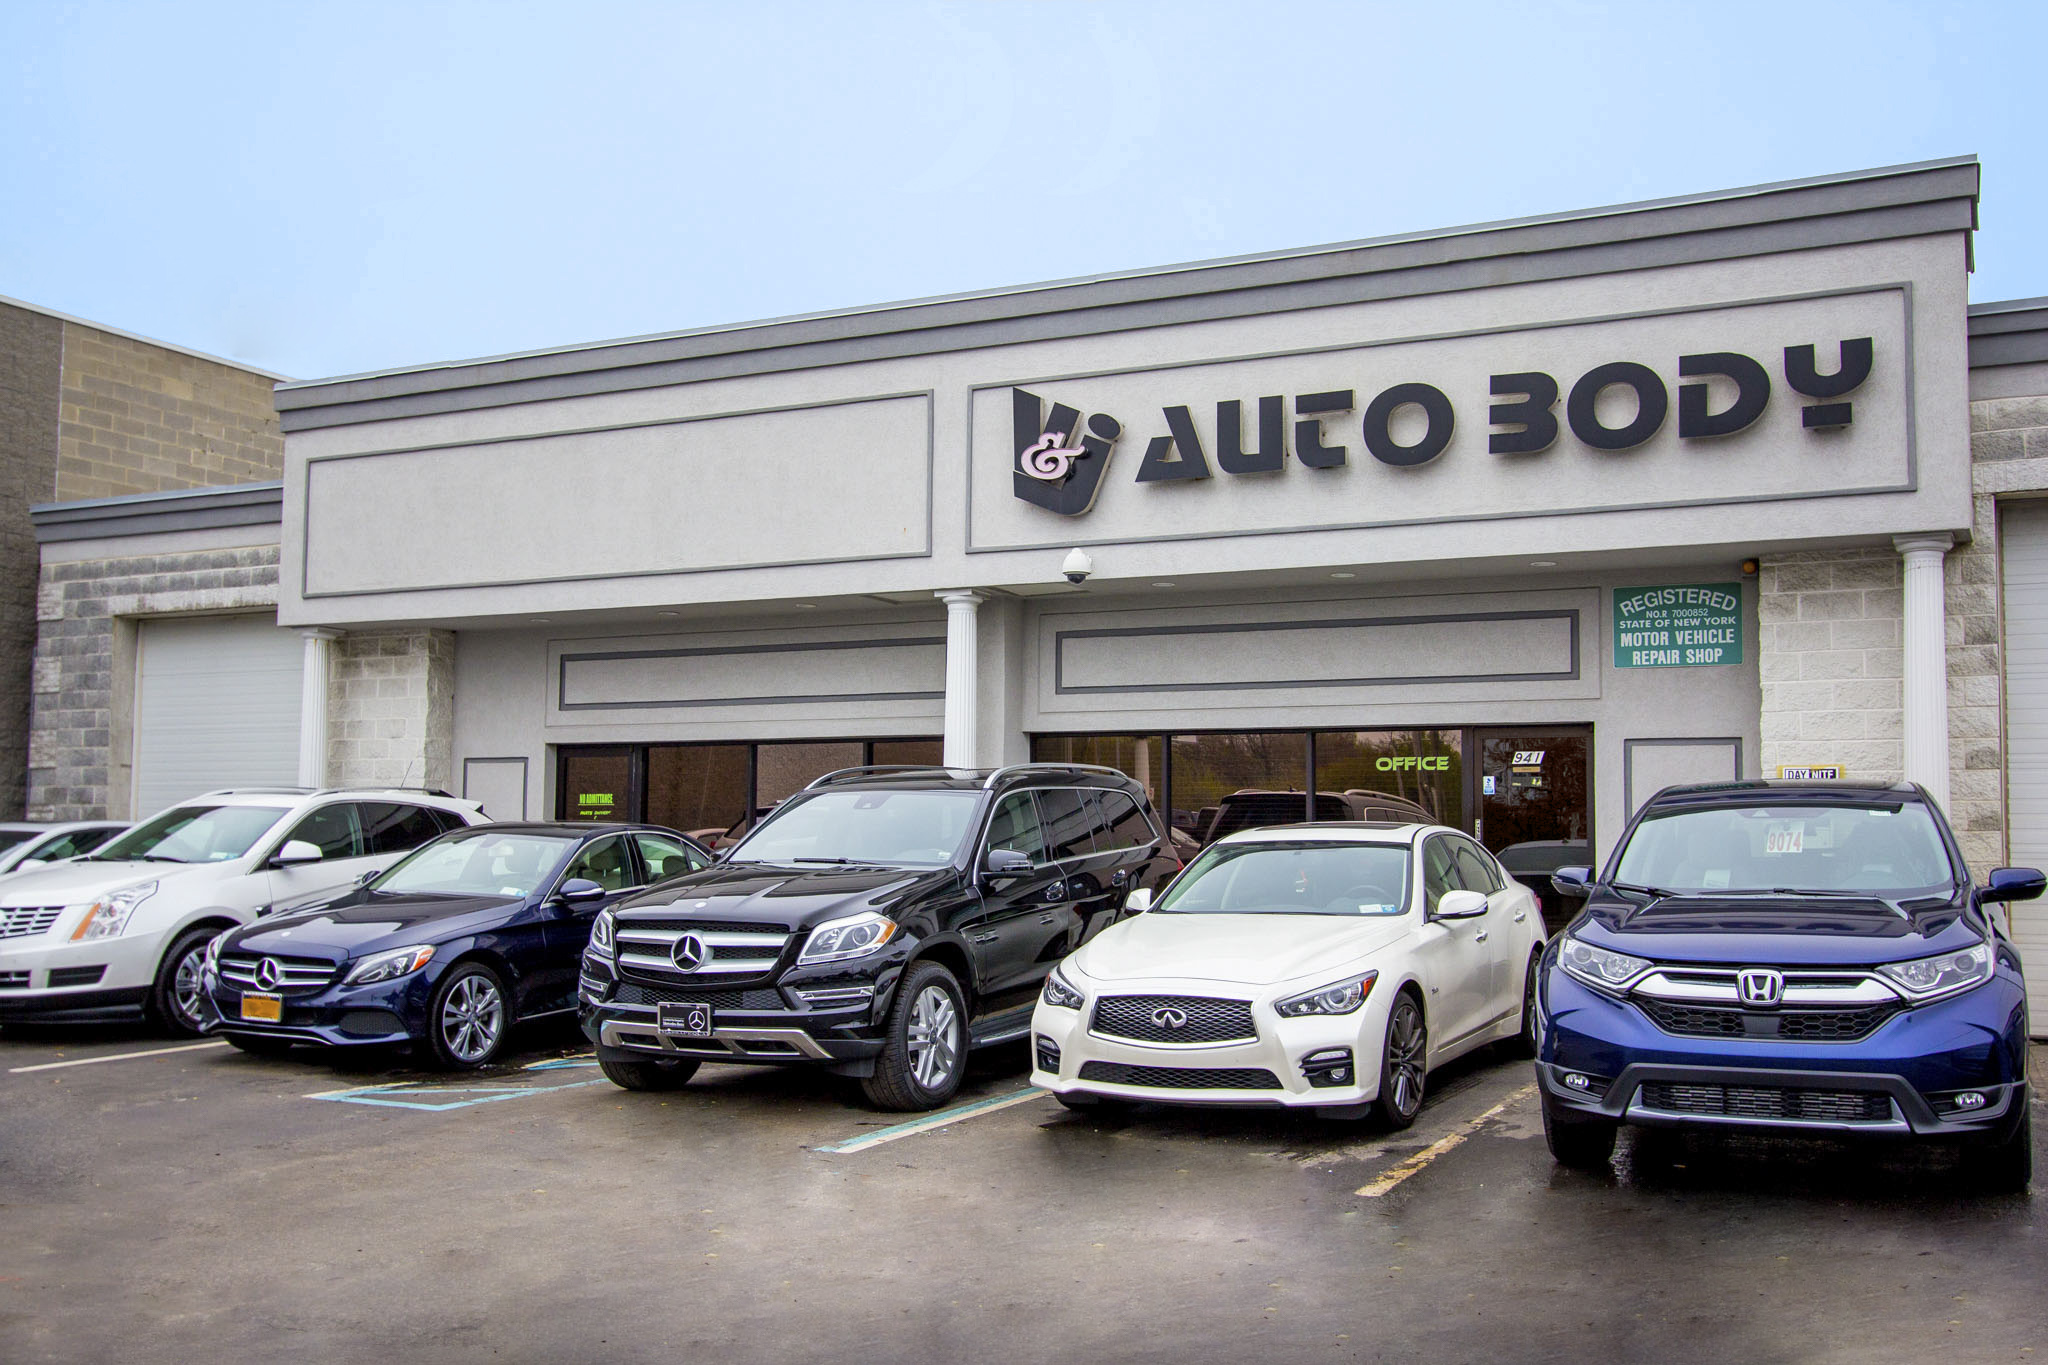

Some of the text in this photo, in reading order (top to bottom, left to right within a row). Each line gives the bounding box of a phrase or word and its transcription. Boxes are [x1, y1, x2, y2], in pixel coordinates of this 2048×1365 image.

[1135, 383, 1456, 483] AUTO
[1489, 337, 1874, 455] BODY
[1620, 588, 1736, 616] REGISTERED
[1672, 608, 1708, 617] 7000852
[1620, 616, 1736, 629] STATE OF NEW YORK
[1620, 629, 1735, 647] MOTOR VEHICLE
[1632, 648, 1723, 665] REPAIR SHOP
[1375, 756, 1449, 771] OFFICE
[1514, 752, 1540, 763] 941
[1788, 770, 1806, 779] DAY
[1768, 832, 1801, 851] 9074
